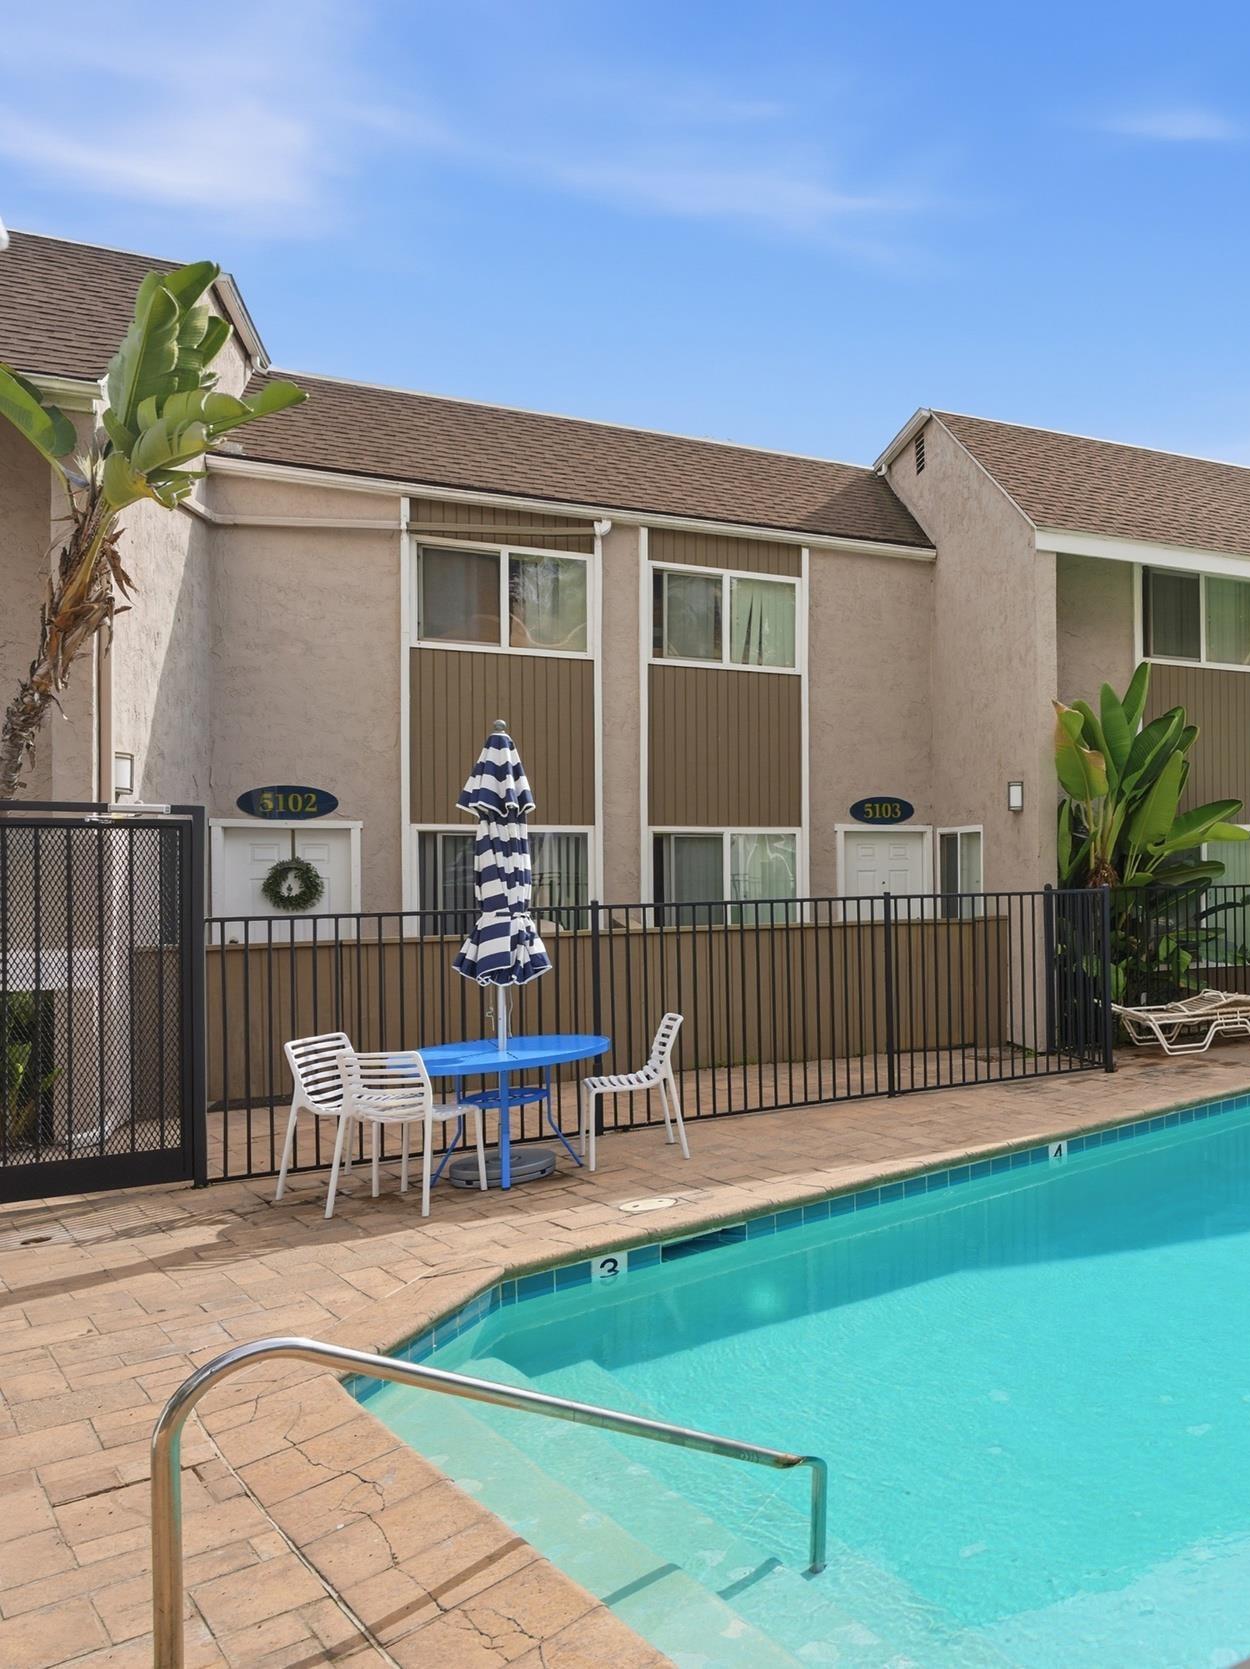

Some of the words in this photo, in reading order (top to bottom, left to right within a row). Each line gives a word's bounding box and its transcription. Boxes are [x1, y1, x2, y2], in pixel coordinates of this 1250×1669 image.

[259, 792, 318, 812] 5102
[864, 803, 902, 818] 5103
[600, 1257, 619, 1279] 3
